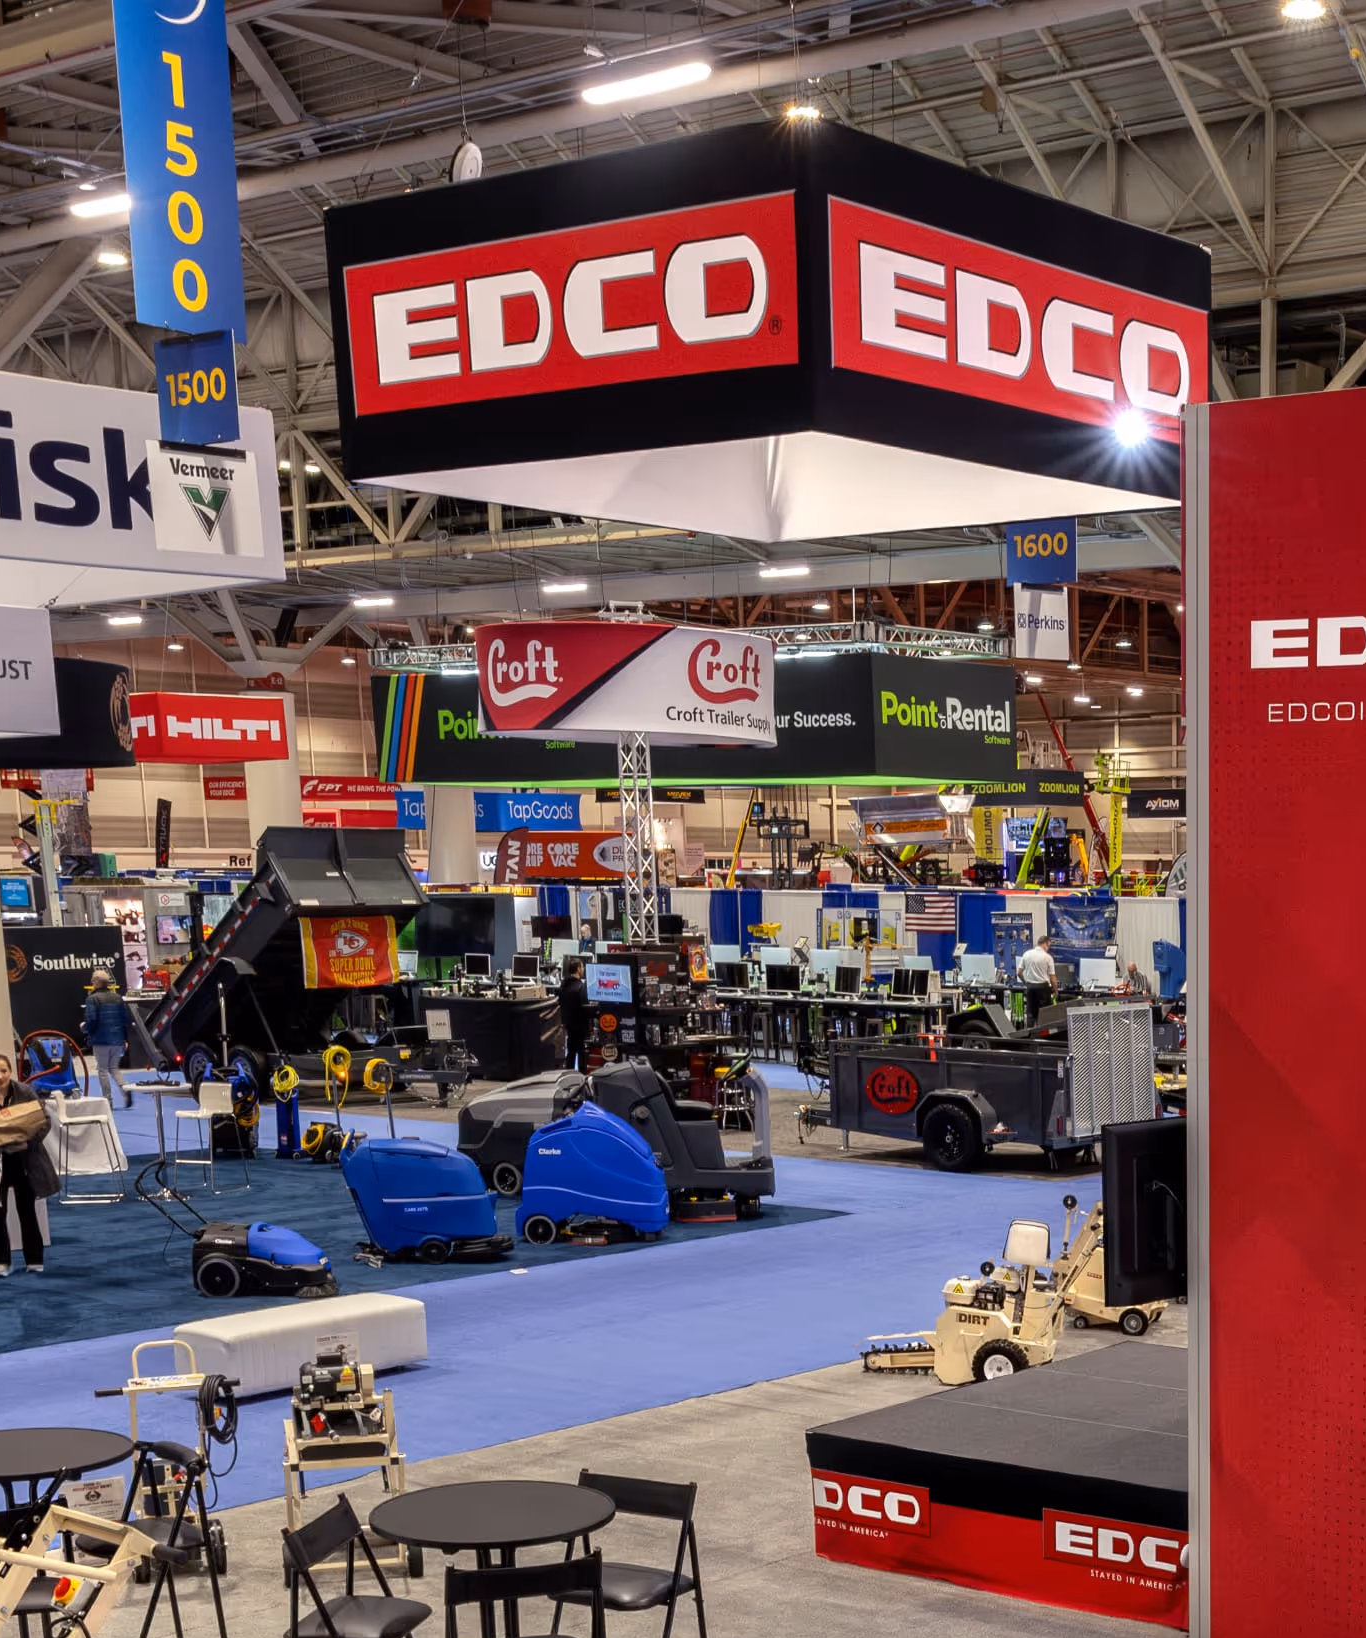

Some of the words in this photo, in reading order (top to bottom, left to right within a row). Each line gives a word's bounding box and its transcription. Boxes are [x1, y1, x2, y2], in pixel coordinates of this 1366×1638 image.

[162, 51, 209, 312] 1500
[372, 233, 770, 386] EDCO
[859, 241, 1191, 417] EDCO
[165, 366, 227, 407] 1500
[169, 457, 235, 481] Vermeer
[1014, 532, 1068, 558] 1600
[1027, 614, 1065, 633] Perkins
[487, 638, 561, 706] Croft
[687, 638, 762, 704] Croft
[666, 706, 704, 723] Croft
[707, 709, 745, 727] Trailer
[793, 711, 856, 728] Success.
[881, 690, 938, 729] Point
[946, 698, 1011, 733] Rental
[167, 714, 281, 742] HILTI
[317, 783, 343, 792] FPT
[972, 783, 1026, 794] ZOOMLION
[1039, 782, 1080, 794] ZOOMLION
[507, 800, 574, 826] TapGoods
[547, 842, 580, 855] CORE
[550, 855, 577, 868] VAC
[33, 953, 116, 971] Southwire
[538, 1147, 562, 1156] Clarke
[849, 1525, 885, 1539] AMERICA
[1090, 1569, 1123, 1583] STAYED
[1125, 1575, 1135, 1585] IN
[1139, 1577, 1184, 1592] AMERICA
